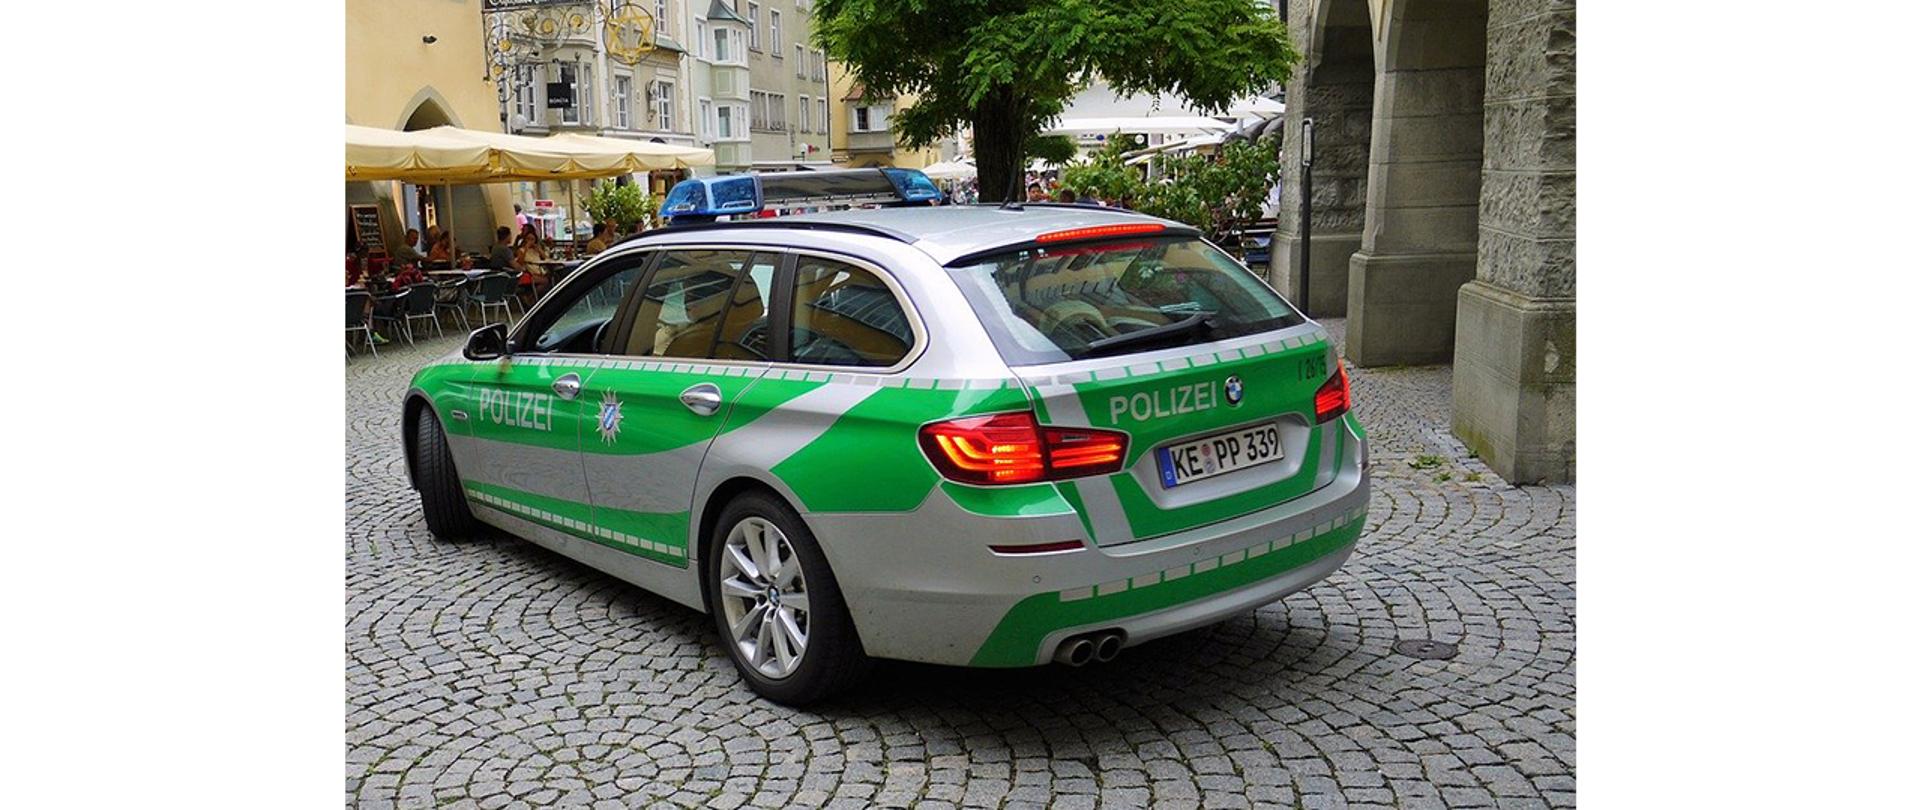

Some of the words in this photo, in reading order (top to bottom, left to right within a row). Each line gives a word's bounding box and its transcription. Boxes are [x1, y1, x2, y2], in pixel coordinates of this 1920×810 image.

[480, 387, 552, 432] POLIZEI
[1109, 380, 1217, 425] POLIZEI
[1171, 445, 1204, 479] KE
[1213, 437, 1240, 469] PP
[1243, 427, 1279, 461] 339
